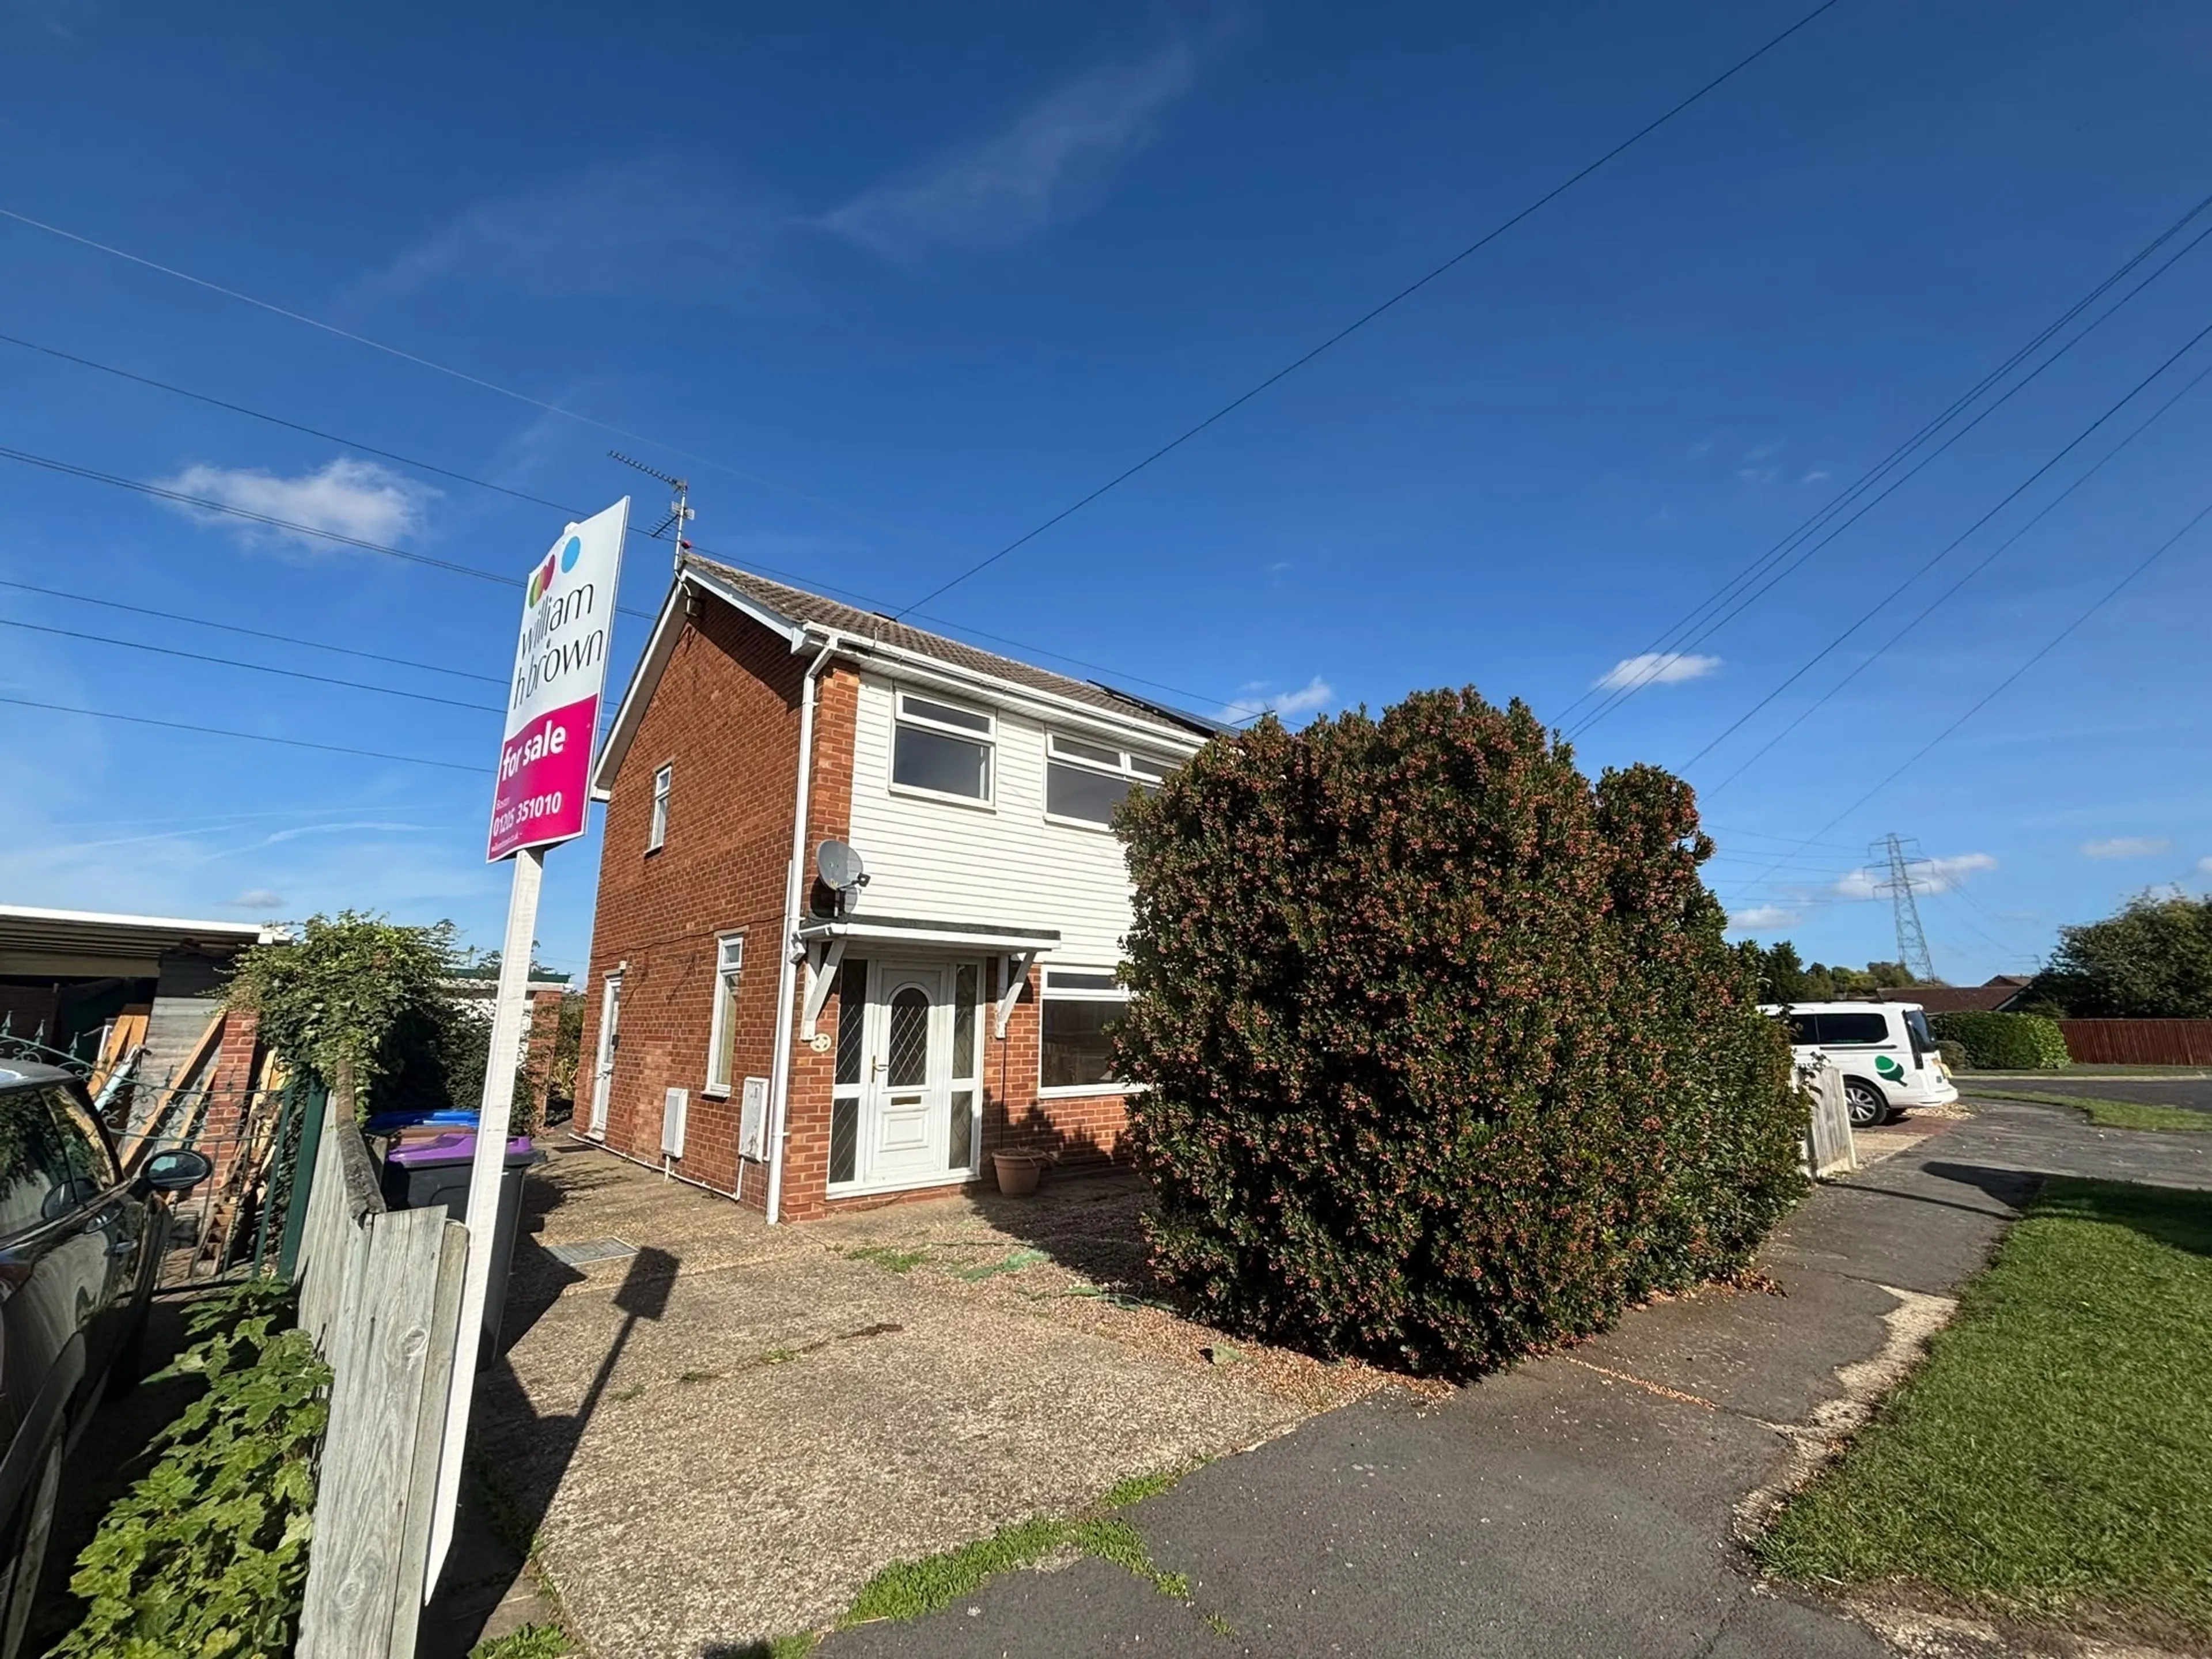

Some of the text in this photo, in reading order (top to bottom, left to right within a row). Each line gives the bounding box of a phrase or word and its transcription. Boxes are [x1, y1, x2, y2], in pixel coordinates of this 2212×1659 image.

[522, 584, 593, 660] william
[502, 720, 566, 781] for sale
[516, 791, 562, 824] 351010
